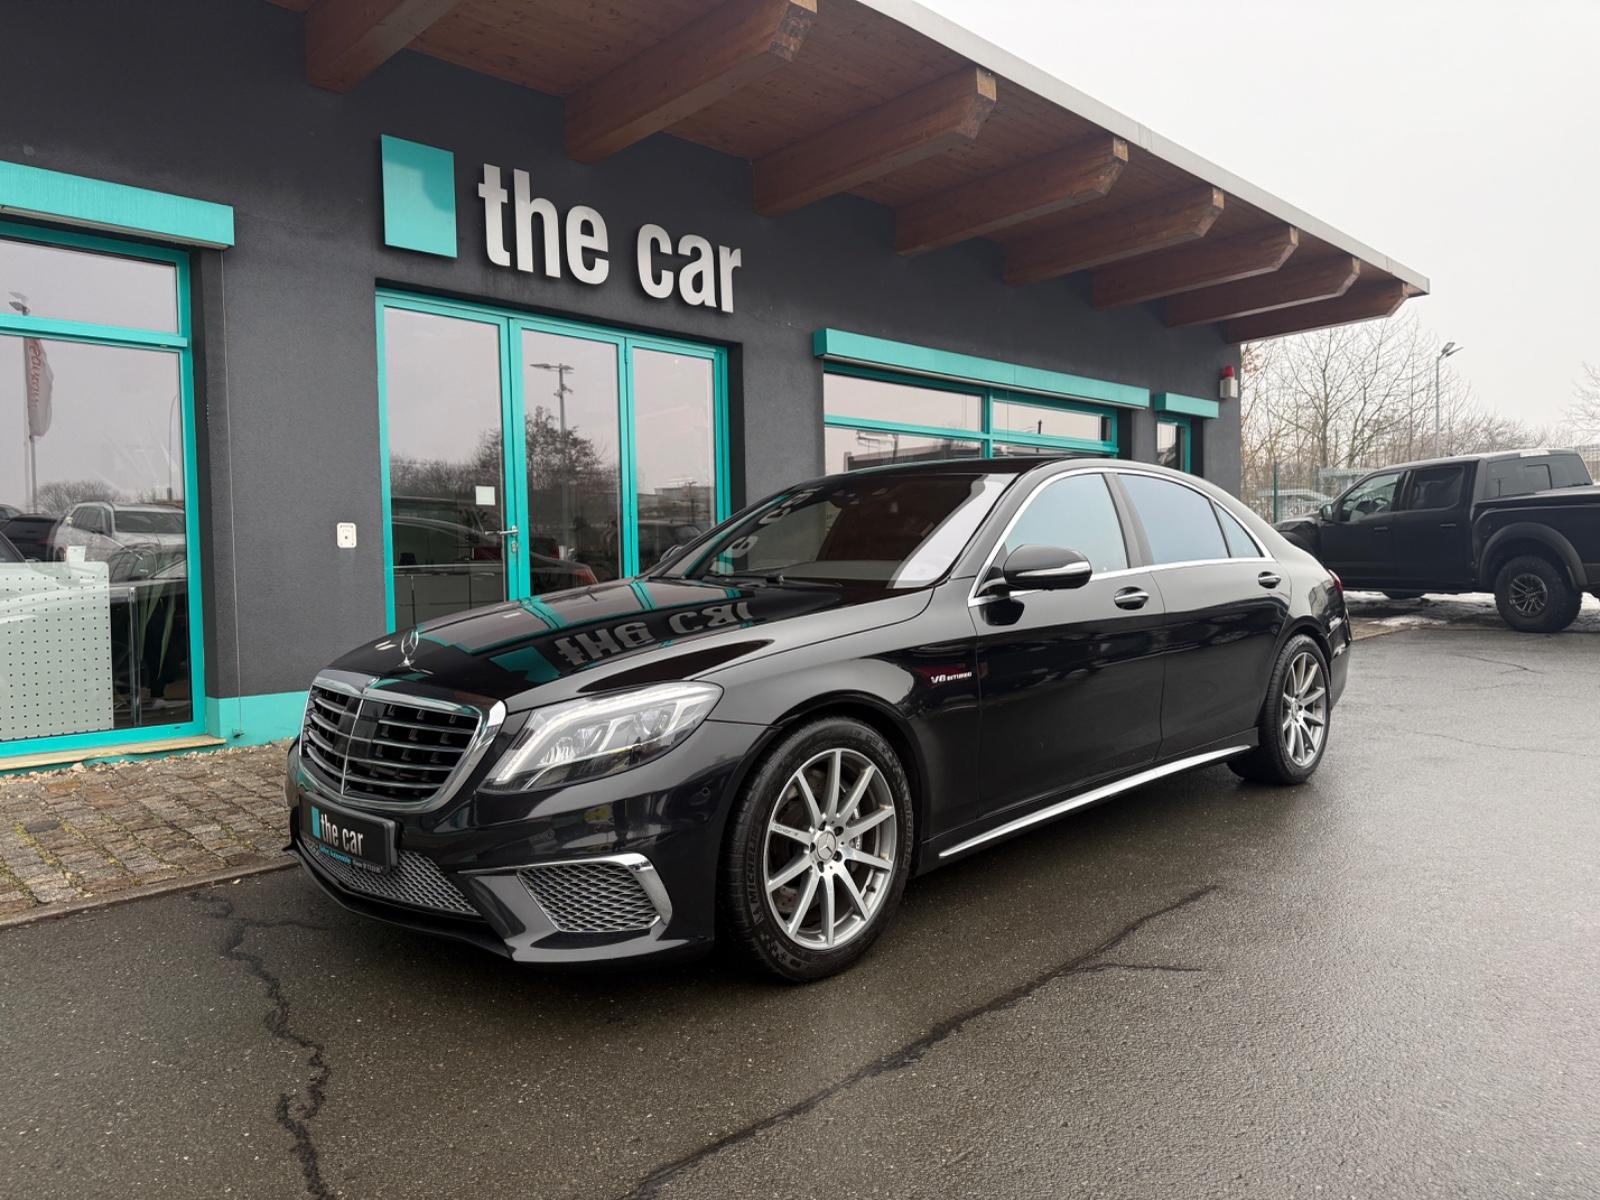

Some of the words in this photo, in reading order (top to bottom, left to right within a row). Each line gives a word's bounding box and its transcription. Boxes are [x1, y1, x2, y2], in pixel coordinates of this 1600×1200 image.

[478, 163, 609, 285] the
[637, 224, 742, 313] car
[930, 674, 946, 684] V8
[320, 814, 339, 847] the
[342, 828, 364, 856] car
